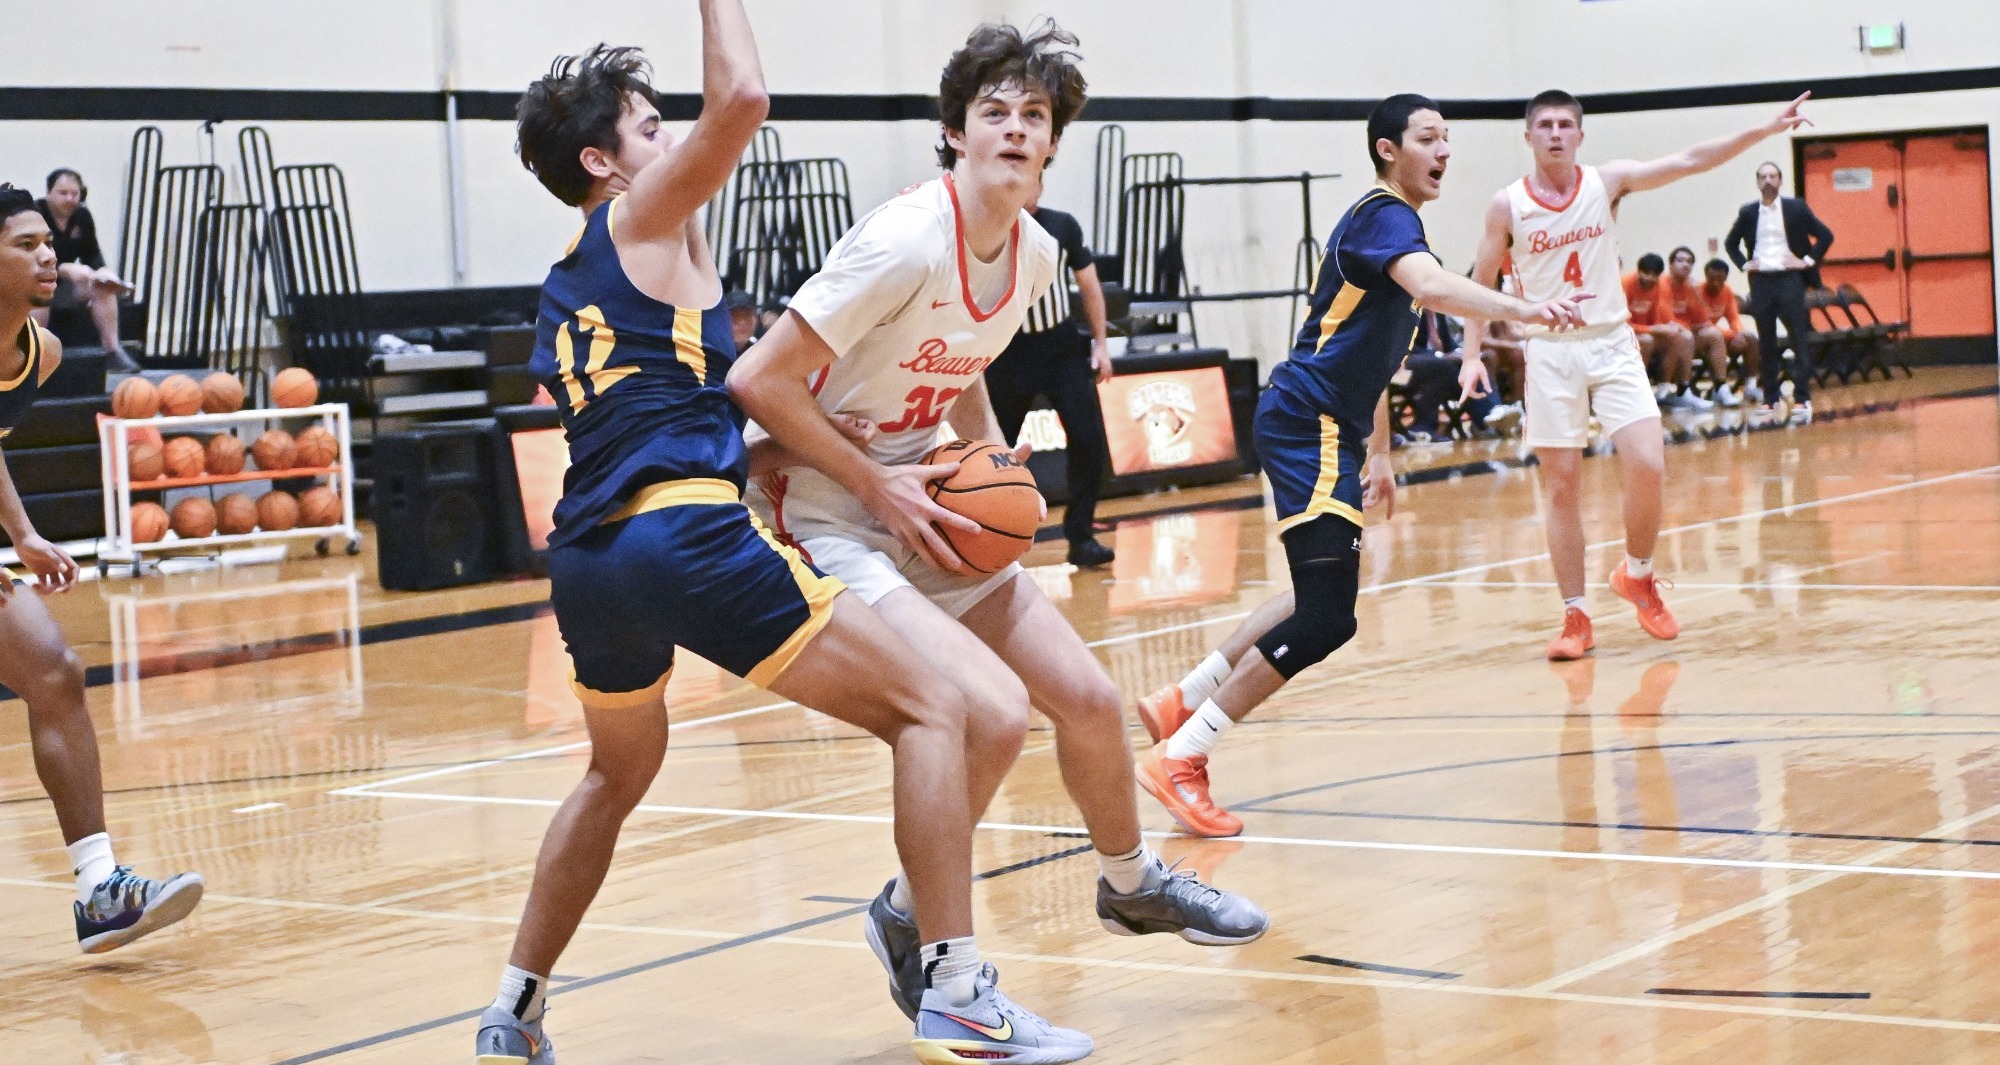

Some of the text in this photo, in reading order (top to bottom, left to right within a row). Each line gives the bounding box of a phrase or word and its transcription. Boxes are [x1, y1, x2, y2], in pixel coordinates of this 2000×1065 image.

[1528, 224, 1604, 254] Beavers
[1563, 250, 1583, 288] 4
[555, 304, 642, 417] 12
[898, 338, 993, 375] Beaver
